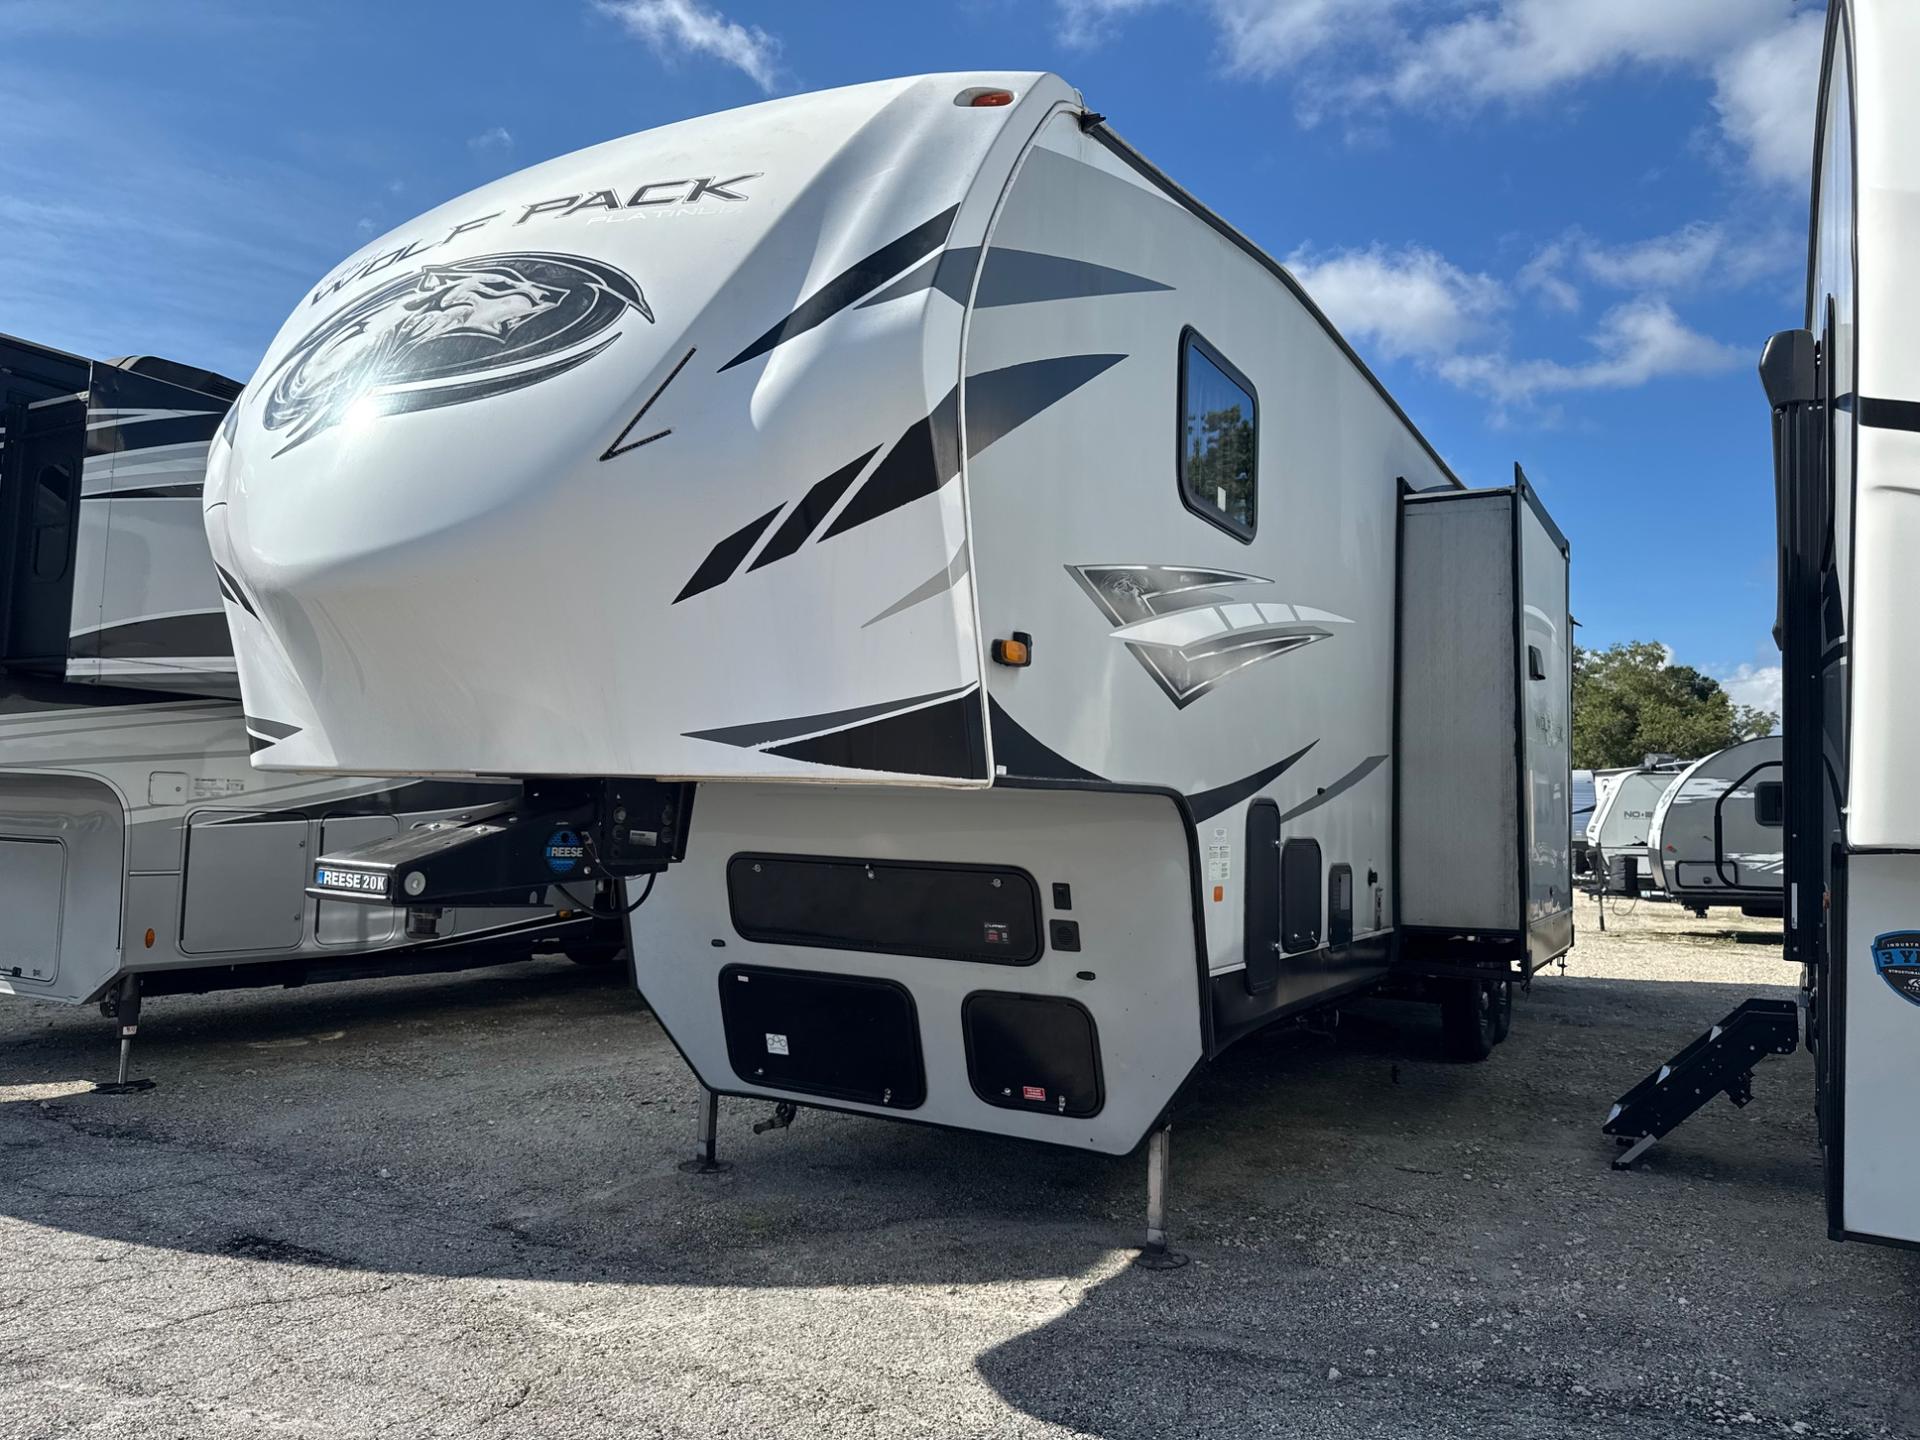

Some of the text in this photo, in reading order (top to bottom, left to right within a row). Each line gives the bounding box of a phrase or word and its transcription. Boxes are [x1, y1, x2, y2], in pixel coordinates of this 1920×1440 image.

[311, 210, 506, 306] WOLF
[511, 171, 765, 227] PACK
[551, 847, 583, 857] REESE
[323, 871, 385, 890] REESE 20K
[1881, 951, 1894, 964] 3
